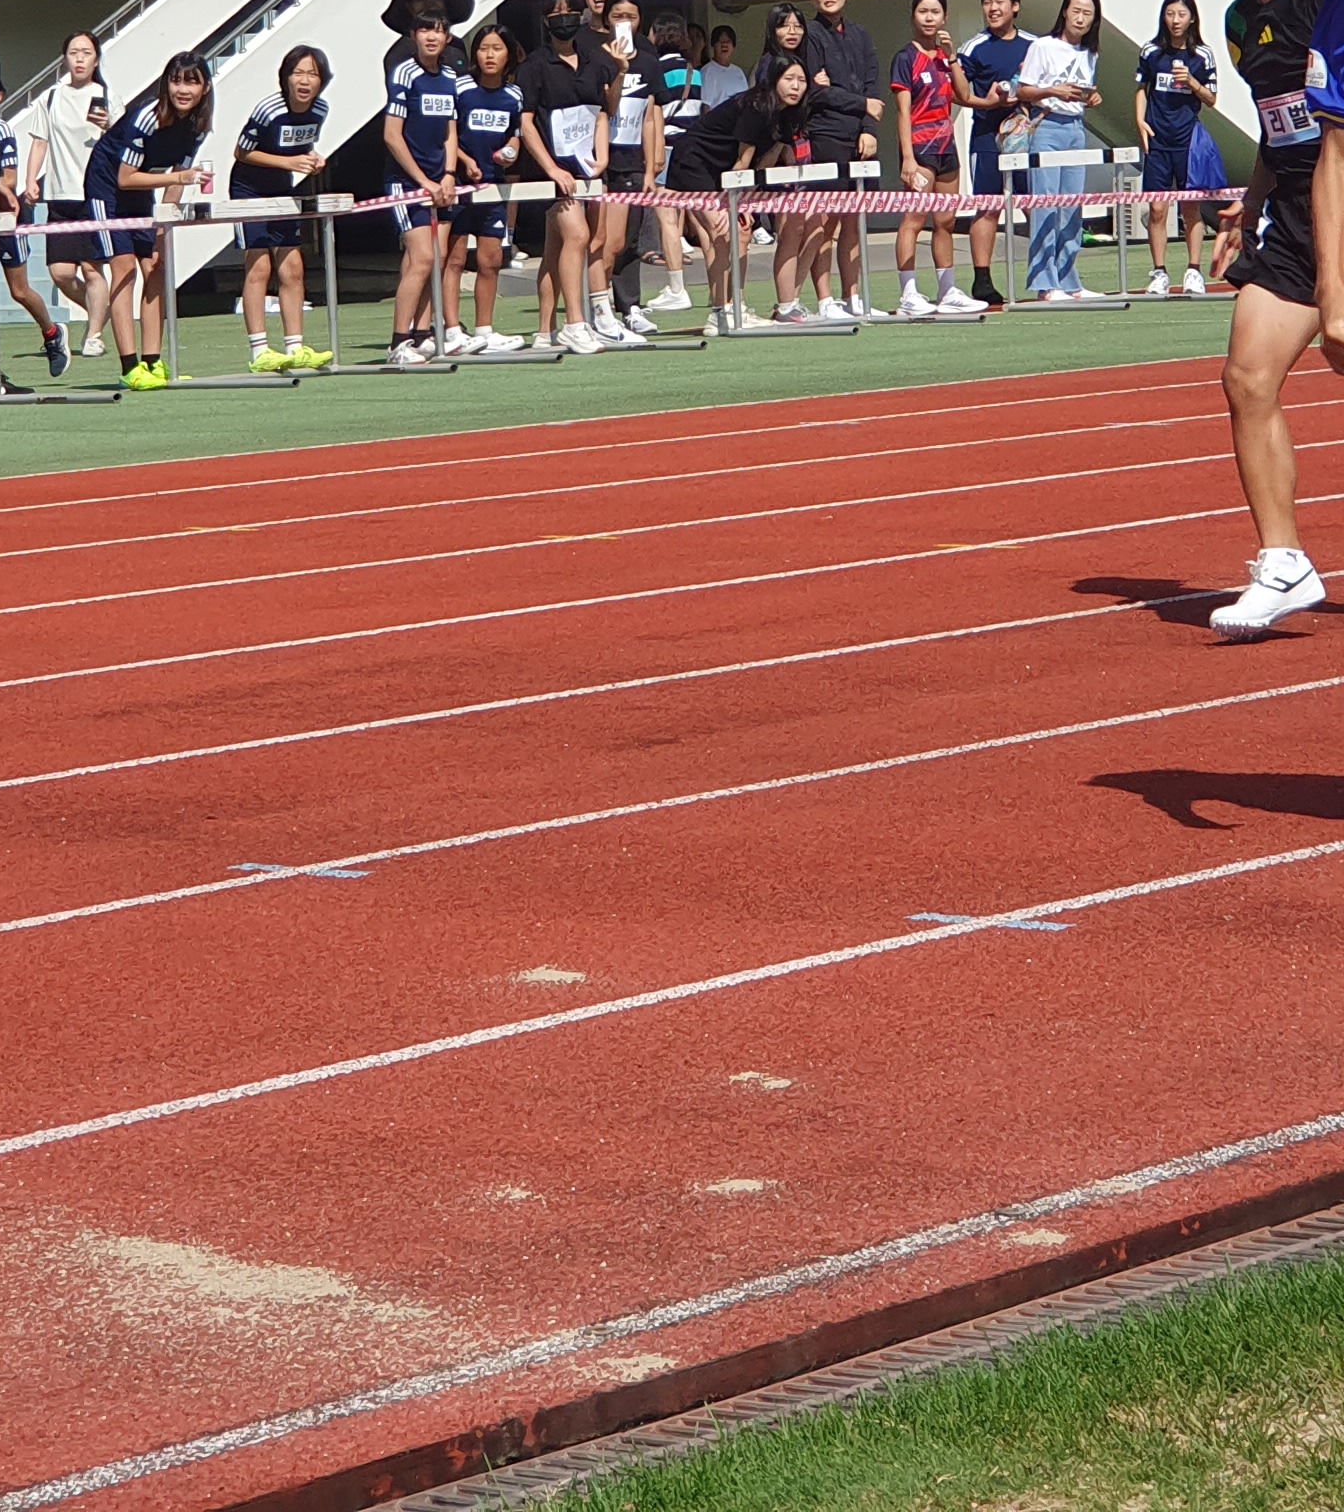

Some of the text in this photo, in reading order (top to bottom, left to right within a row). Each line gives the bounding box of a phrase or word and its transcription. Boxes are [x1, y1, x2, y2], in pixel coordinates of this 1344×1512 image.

[622, 73, 642, 88] IKE
[423, 97, 452, 112] 밀양초
[471, 112, 508, 128] 밀양초
